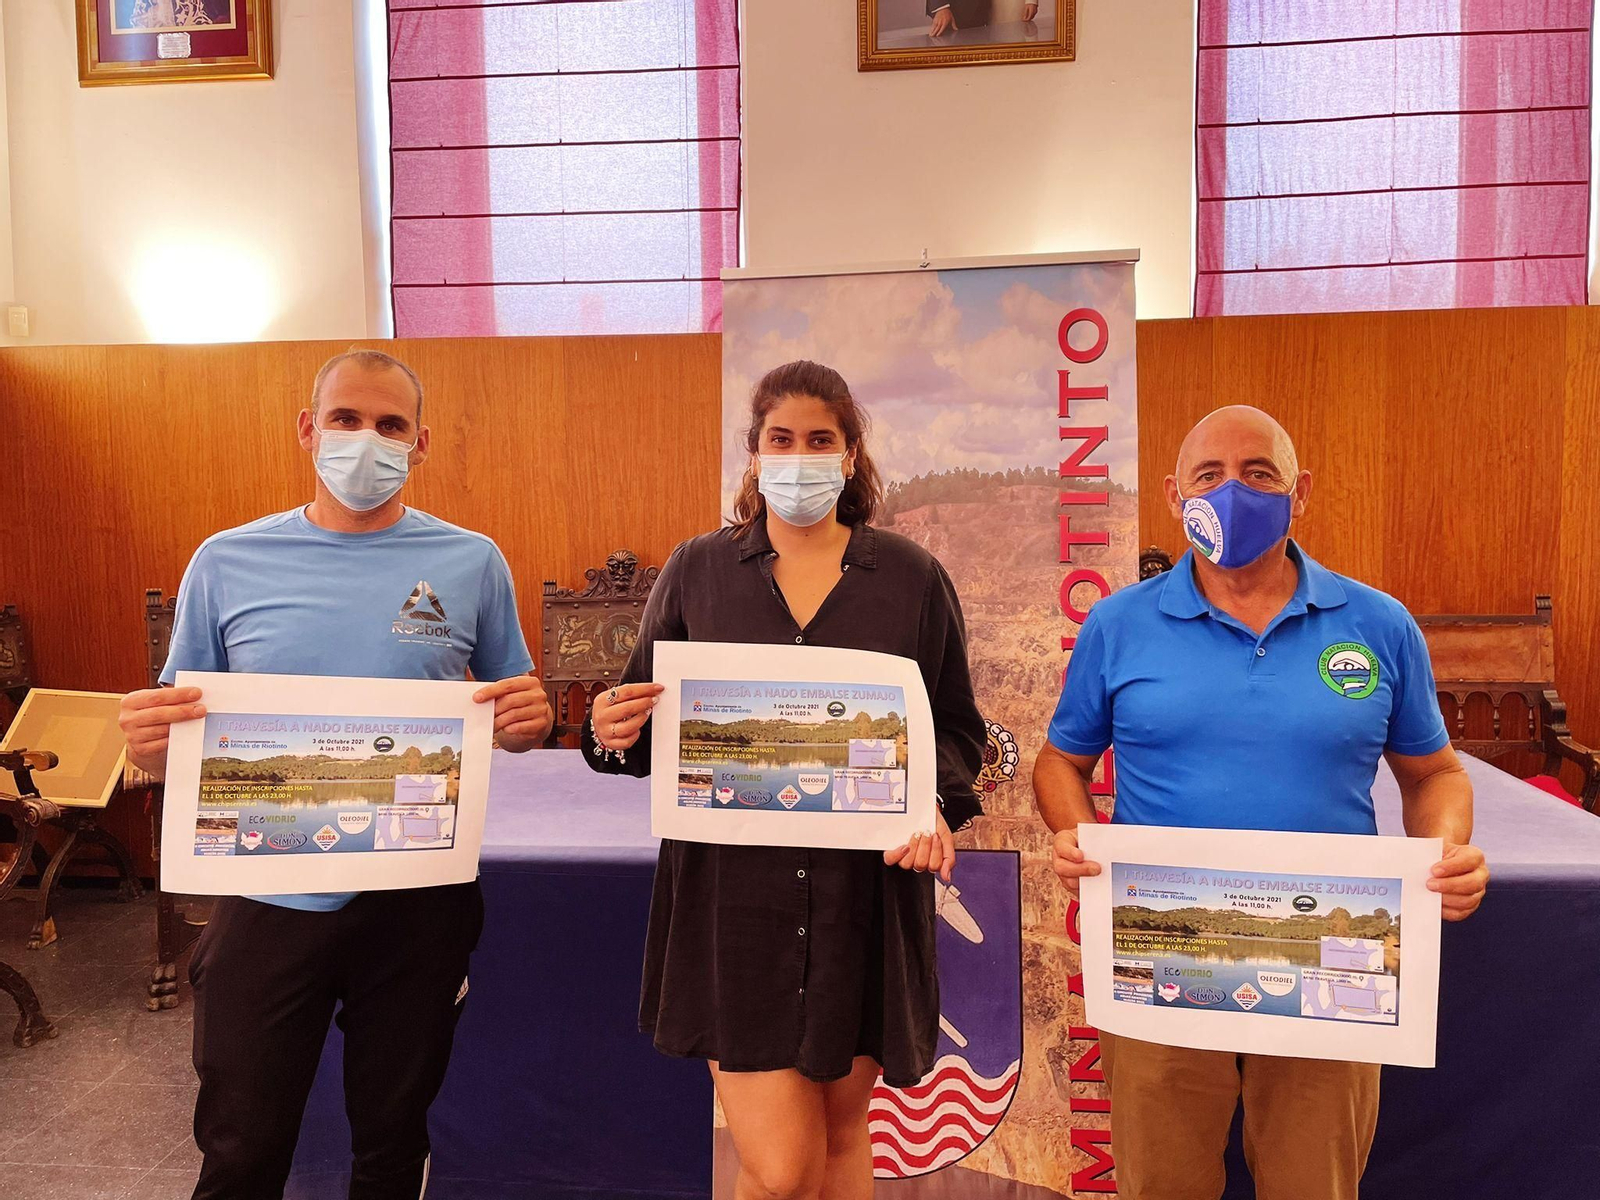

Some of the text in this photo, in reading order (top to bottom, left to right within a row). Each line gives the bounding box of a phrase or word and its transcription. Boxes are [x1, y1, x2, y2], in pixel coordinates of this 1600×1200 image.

[1214, 521, 1222, 553] HUELVA
[1326, 644, 1360, 655] NATACION
[1363, 650, 1377, 676] HUELVA
[700, 686, 751, 697] TRAVESÍA
[753, 689, 762, 698] A
[765, 689, 798, 698] NADO
[800, 689, 850, 699] EMBALSE
[851, 691, 896, 700] ZUMAJO
[226, 719, 287, 732] TRAVESÍA
[290, 723, 299, 732] A
[303, 723, 341, 733] NADO
[345, 723, 400, 734] EMBALSE
[402, 724, 454, 735] ZUMAJO
[1132, 871, 1196, 885] TRAVESÍA
[1199, 877, 1208, 886] A
[1212, 877, 1254, 889] NADO
[1258, 880, 1322, 893] EMBALSE
[1326, 883, 1388, 896] ZUMAJO
[1170, 894, 1198, 902] Riotinto
[1115, 934, 1154, 942] REALIZACIÓN
[1163, 936, 1208, 945] INSCRIPCIONES
[1260, 976, 1293, 984] OLEODIEL
